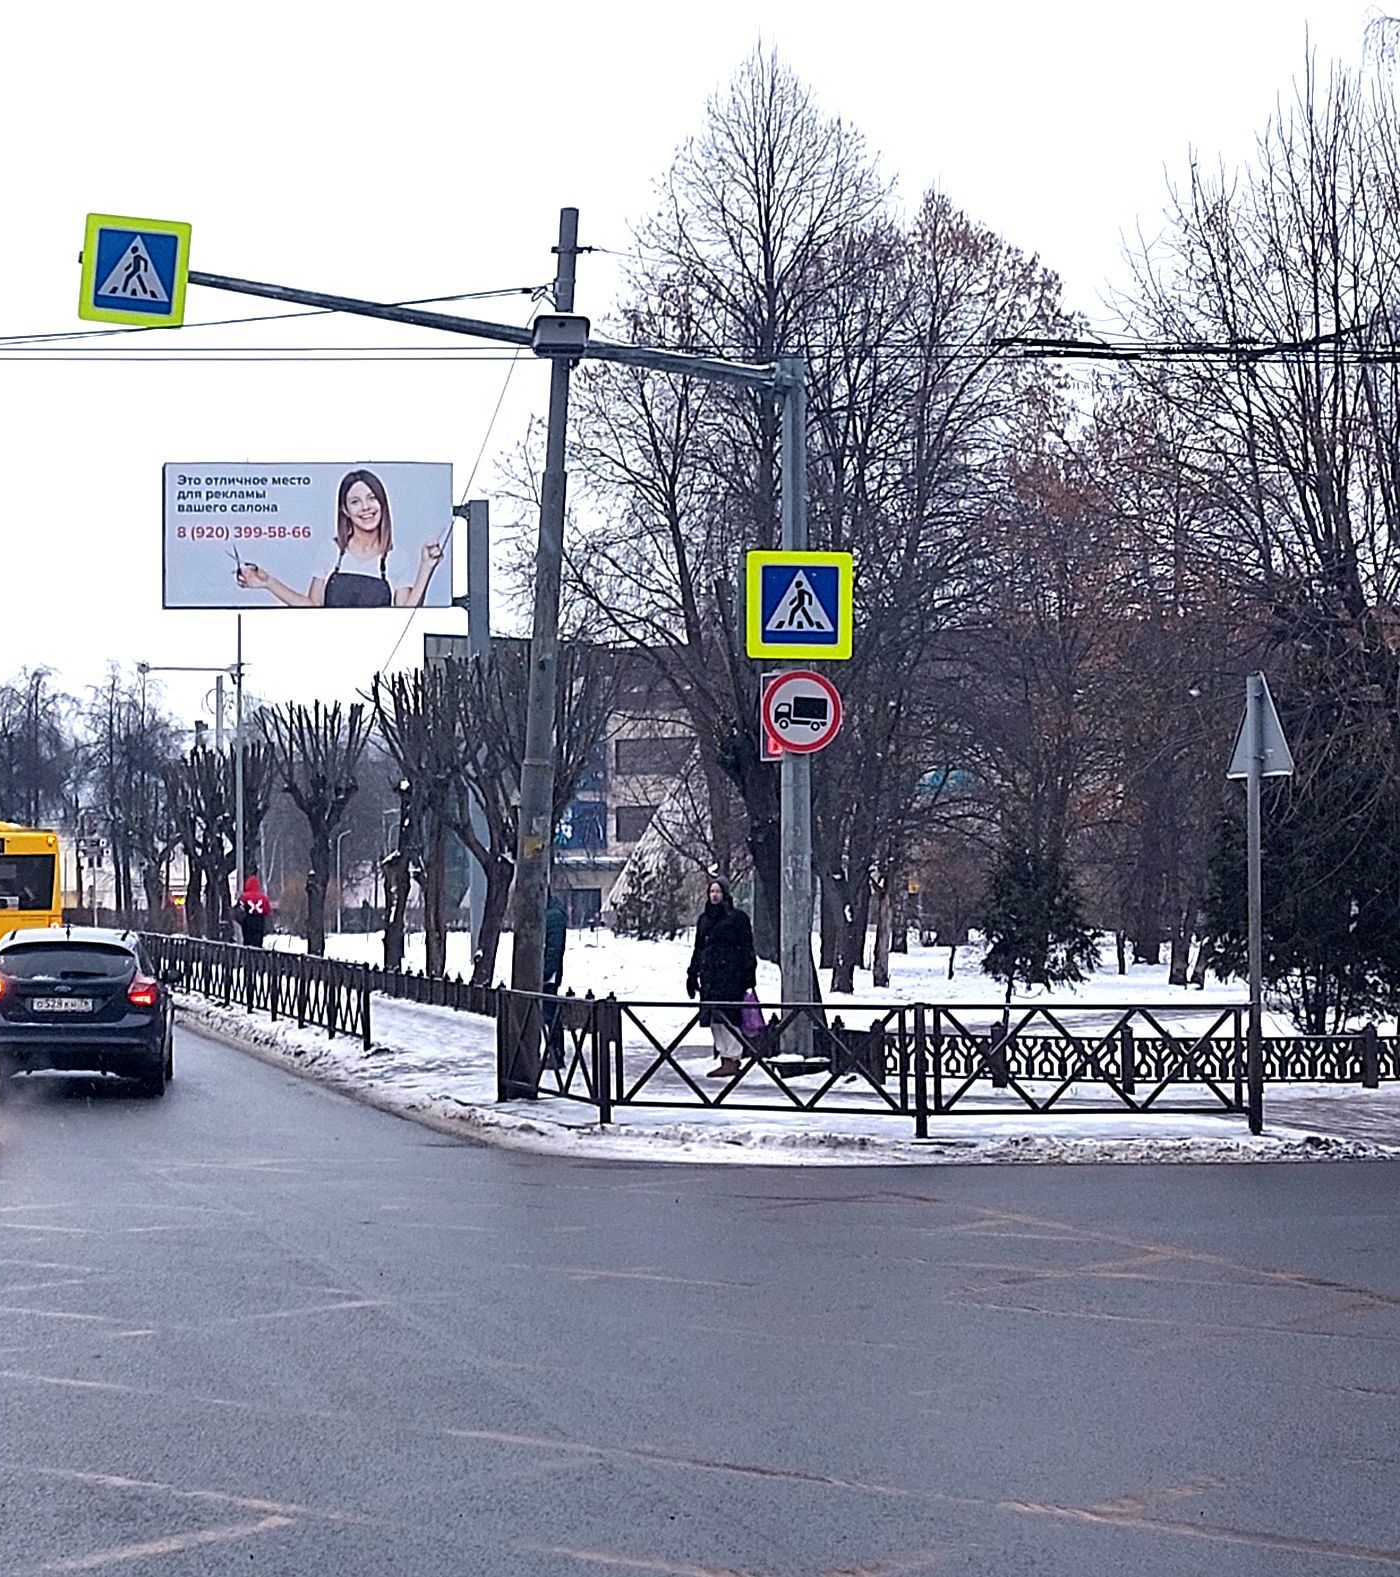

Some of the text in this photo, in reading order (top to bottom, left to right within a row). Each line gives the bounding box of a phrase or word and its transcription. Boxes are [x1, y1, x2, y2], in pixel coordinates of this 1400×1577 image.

[177, 474, 311, 486] Это отличное место
[177, 490, 267, 501] для рекламы
[177, 503, 278, 513] вашего салона
[177, 525, 311, 541] 8 (920) 399-58-66
